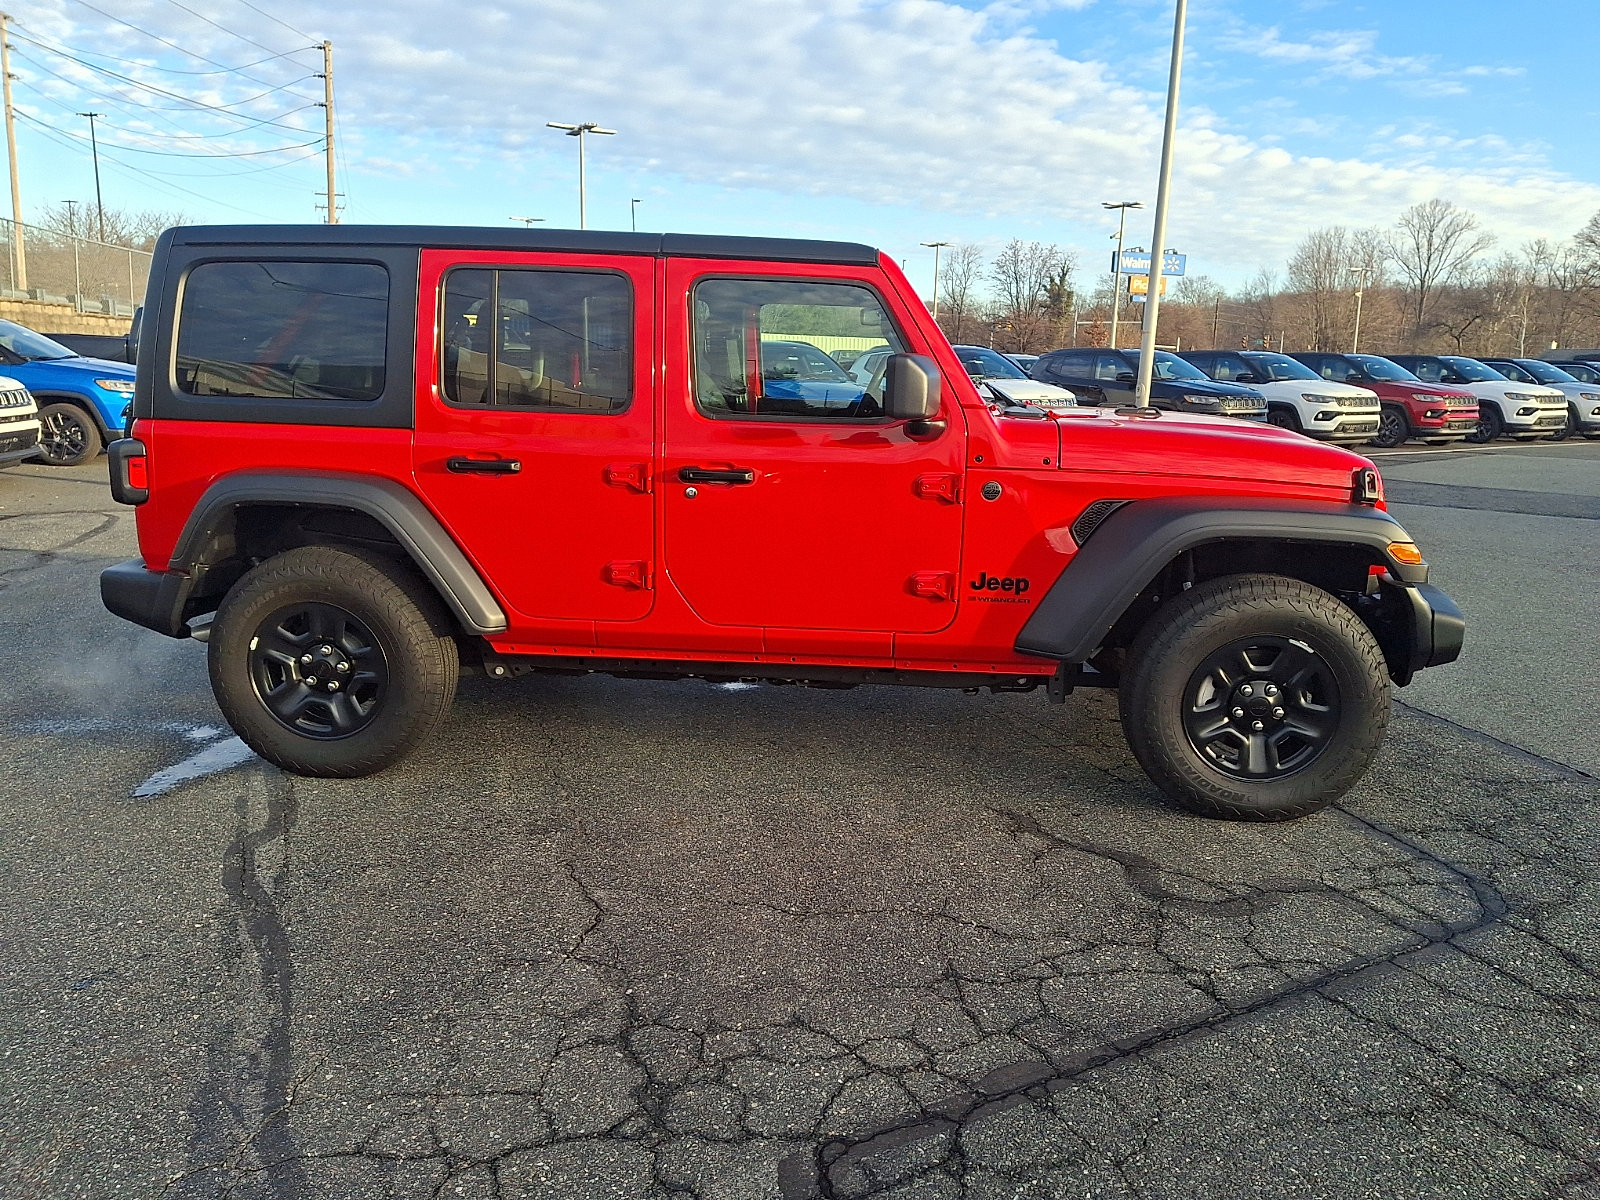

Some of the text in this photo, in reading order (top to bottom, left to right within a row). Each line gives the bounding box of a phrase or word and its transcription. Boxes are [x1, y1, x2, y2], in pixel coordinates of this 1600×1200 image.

[1121, 256, 1166, 270] Walmt
[970, 571, 1030, 596] Jeep
[976, 595, 1030, 604] WRANGLER
